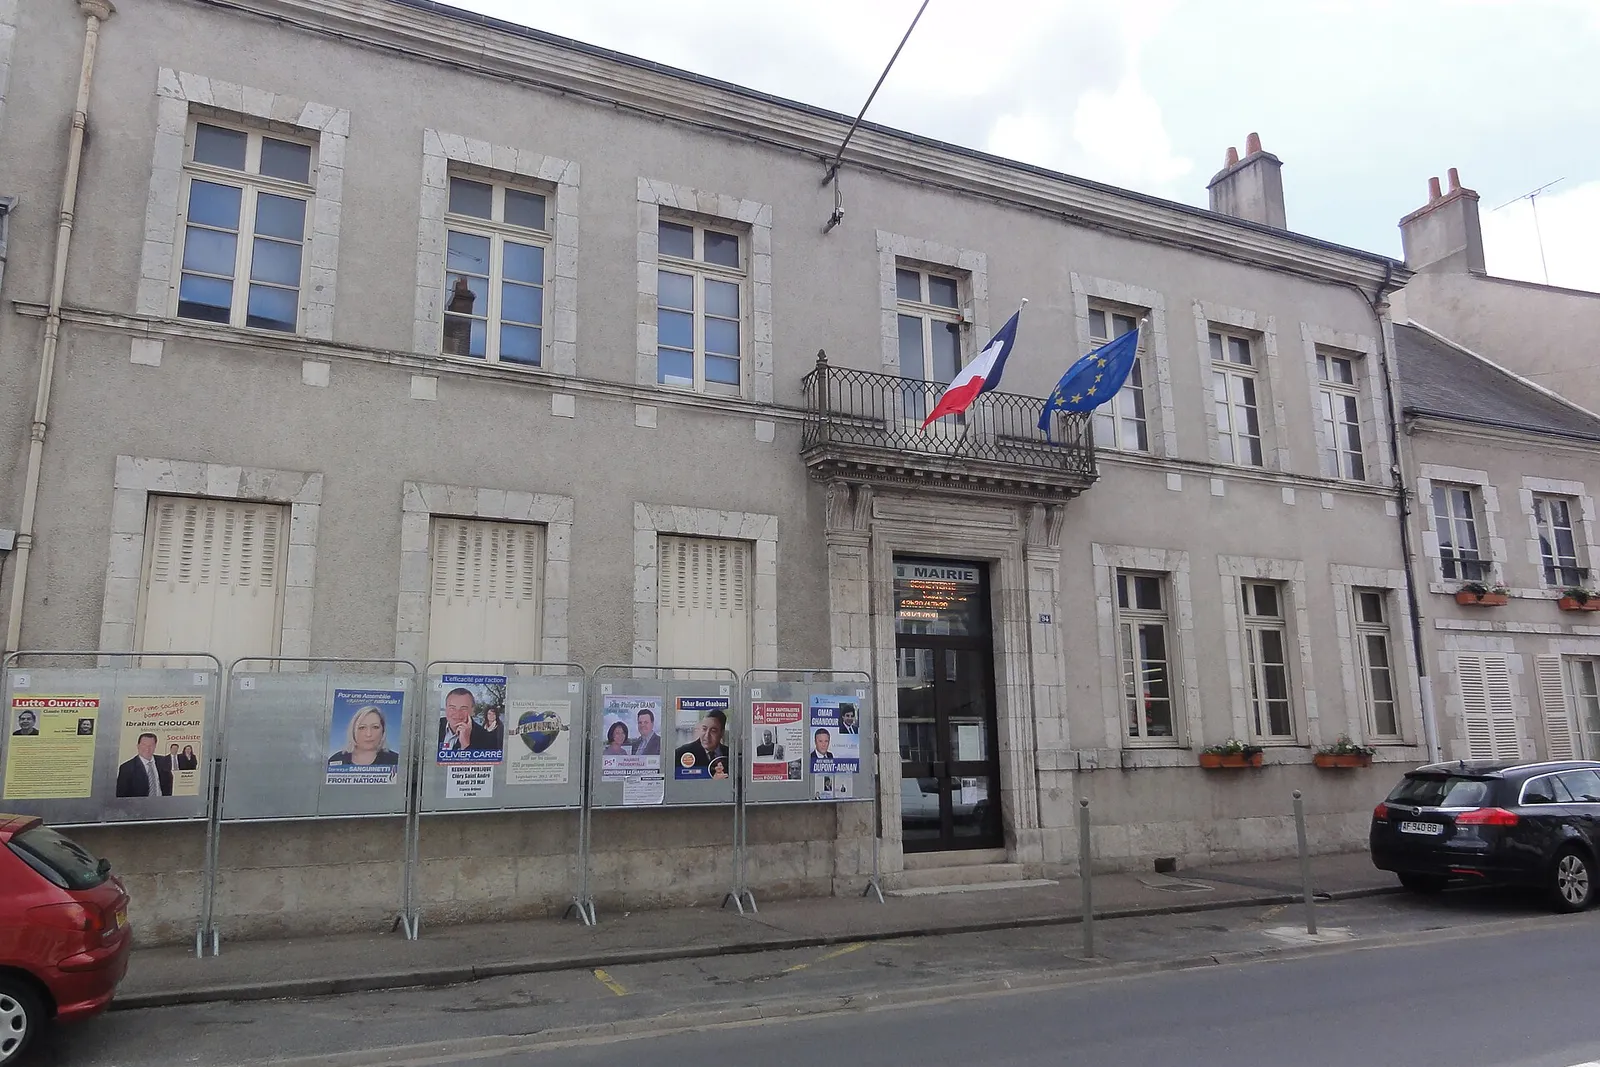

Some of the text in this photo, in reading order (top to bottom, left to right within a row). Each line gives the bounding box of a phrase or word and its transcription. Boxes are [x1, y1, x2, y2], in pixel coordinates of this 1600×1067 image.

[914, 567, 973, 580] MAIRIE
[15, 699, 97, 708] Lutte Ouvrière
[160, 699, 189, 709] société
[817, 708, 833, 717] OMAR
[439, 749, 503, 758] OLIVIER CARRÉ
[813, 763, 858, 772] DUPONT-AIGNAN
